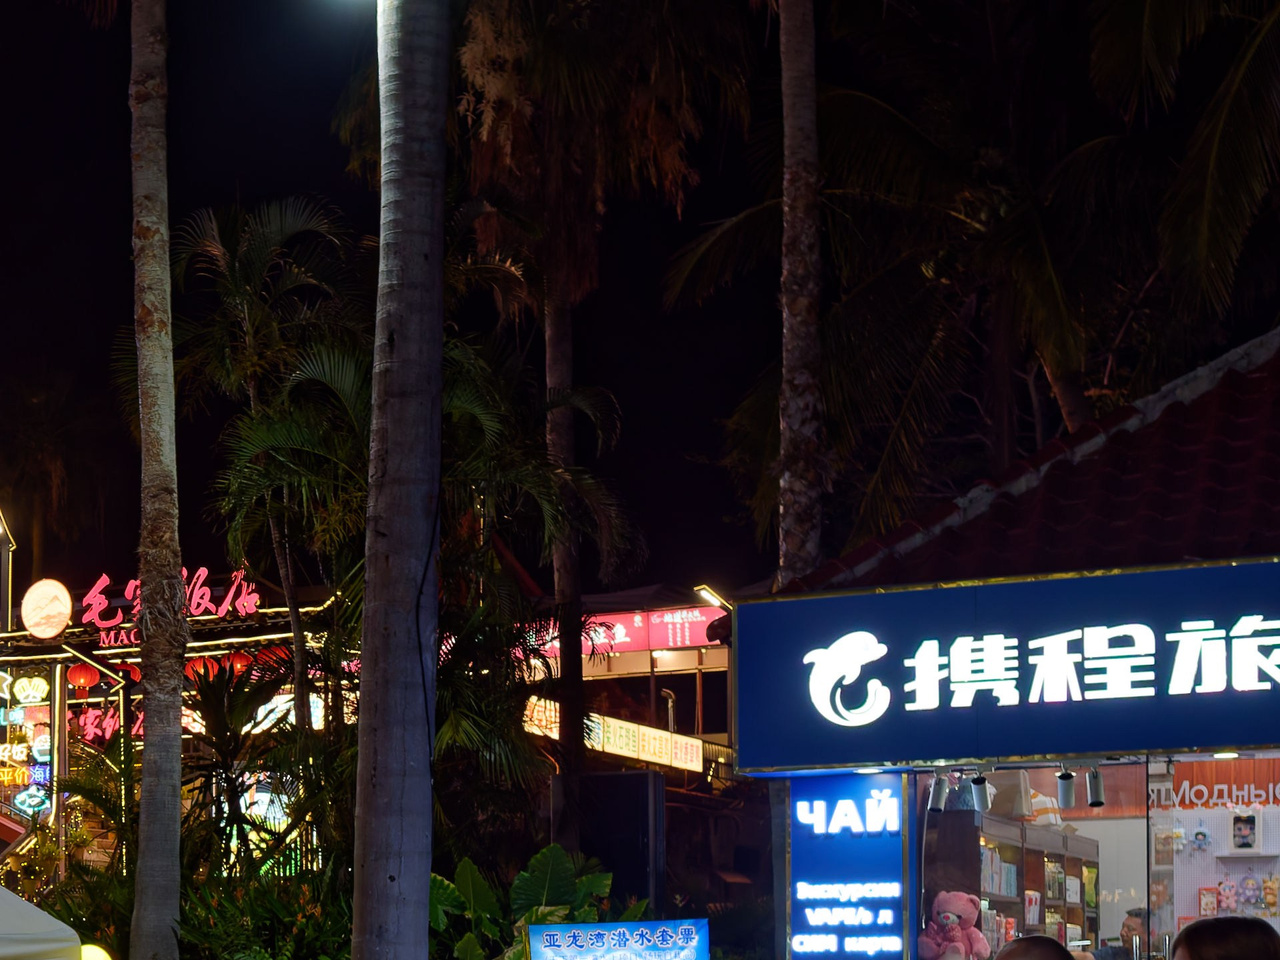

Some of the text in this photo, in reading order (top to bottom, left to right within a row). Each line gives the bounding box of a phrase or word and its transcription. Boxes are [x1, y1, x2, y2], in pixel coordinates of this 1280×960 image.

[904, 615, 1280, 711] 携程旅
[0, 765, 51, 786] 平价海
[797, 789, 900, 834] ЧАЙ
[541, 926, 699, 950] 亚龙湾潜水套票
